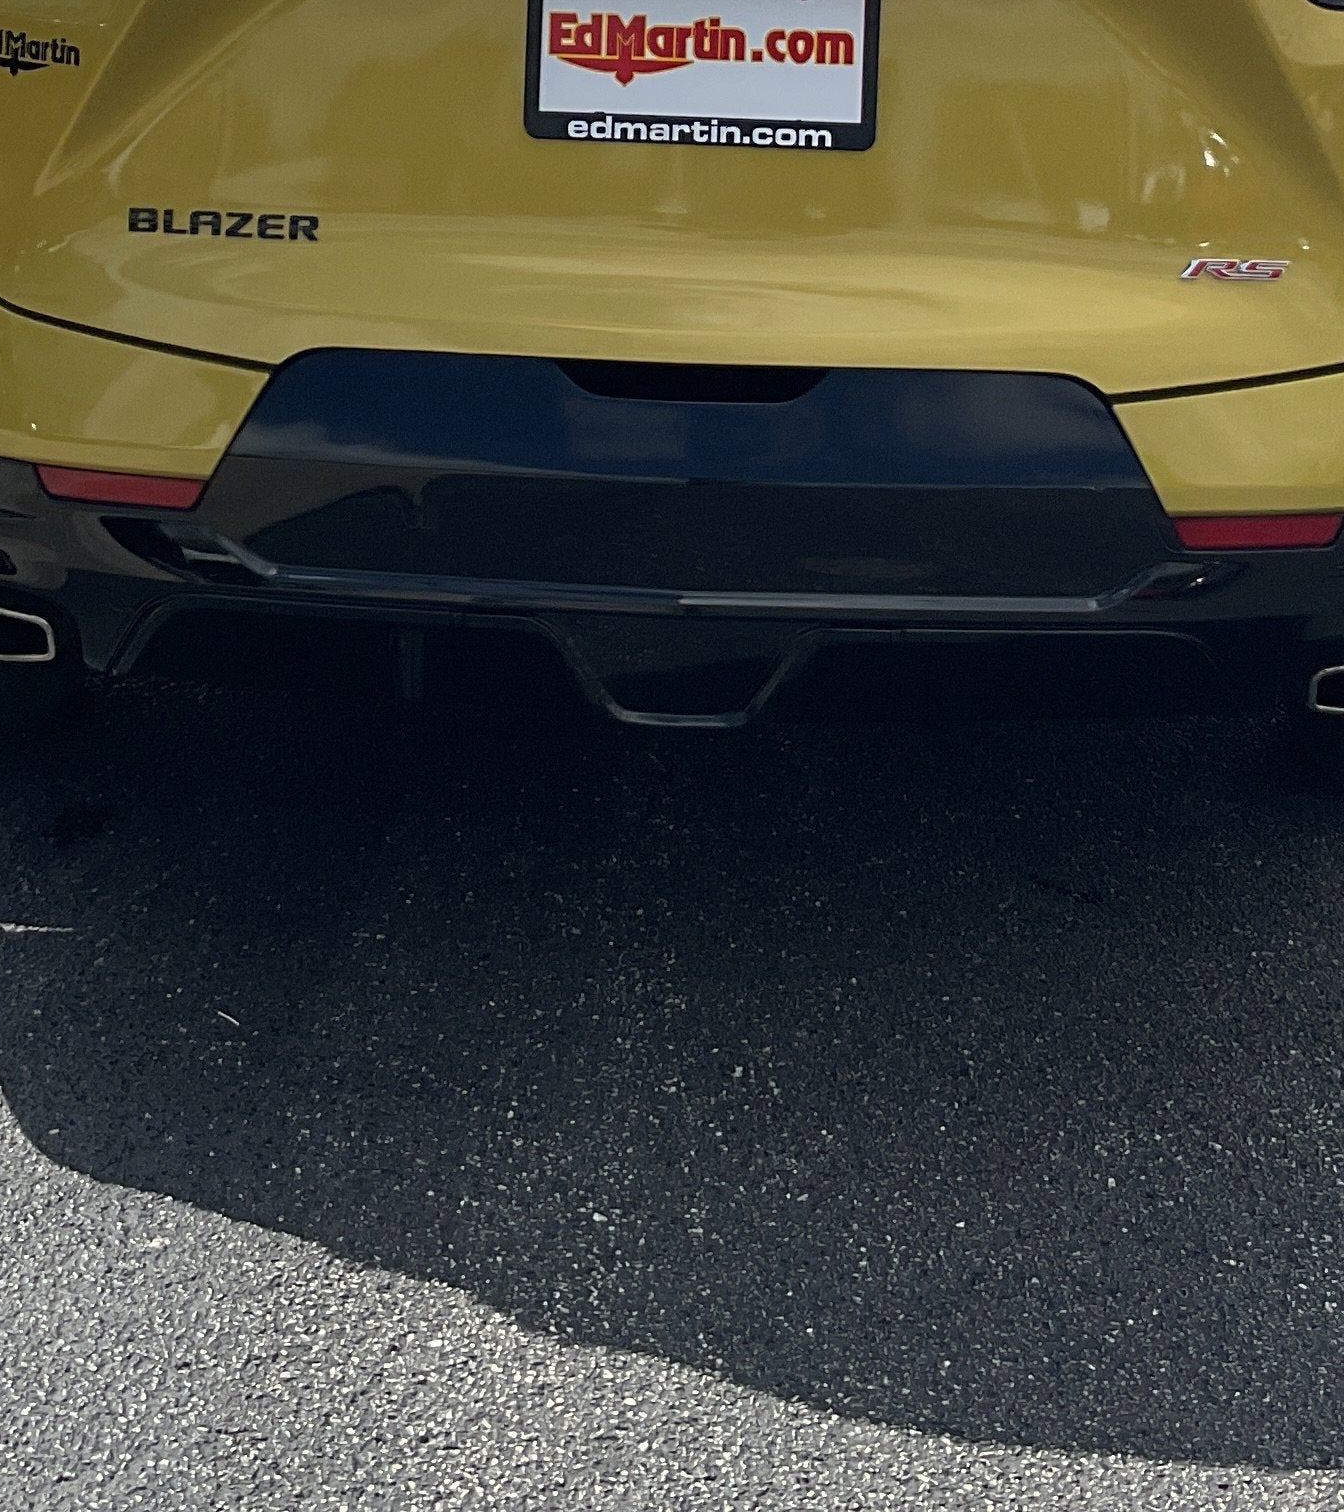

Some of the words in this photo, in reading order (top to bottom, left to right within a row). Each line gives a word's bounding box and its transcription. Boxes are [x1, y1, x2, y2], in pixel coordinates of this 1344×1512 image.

[549, 12, 855, 65] EdMartin.com
[567, 116, 833, 148] edmartin.com
[128, 207, 320, 242] BLAZER
[1179, 257, 1292, 281] RS
